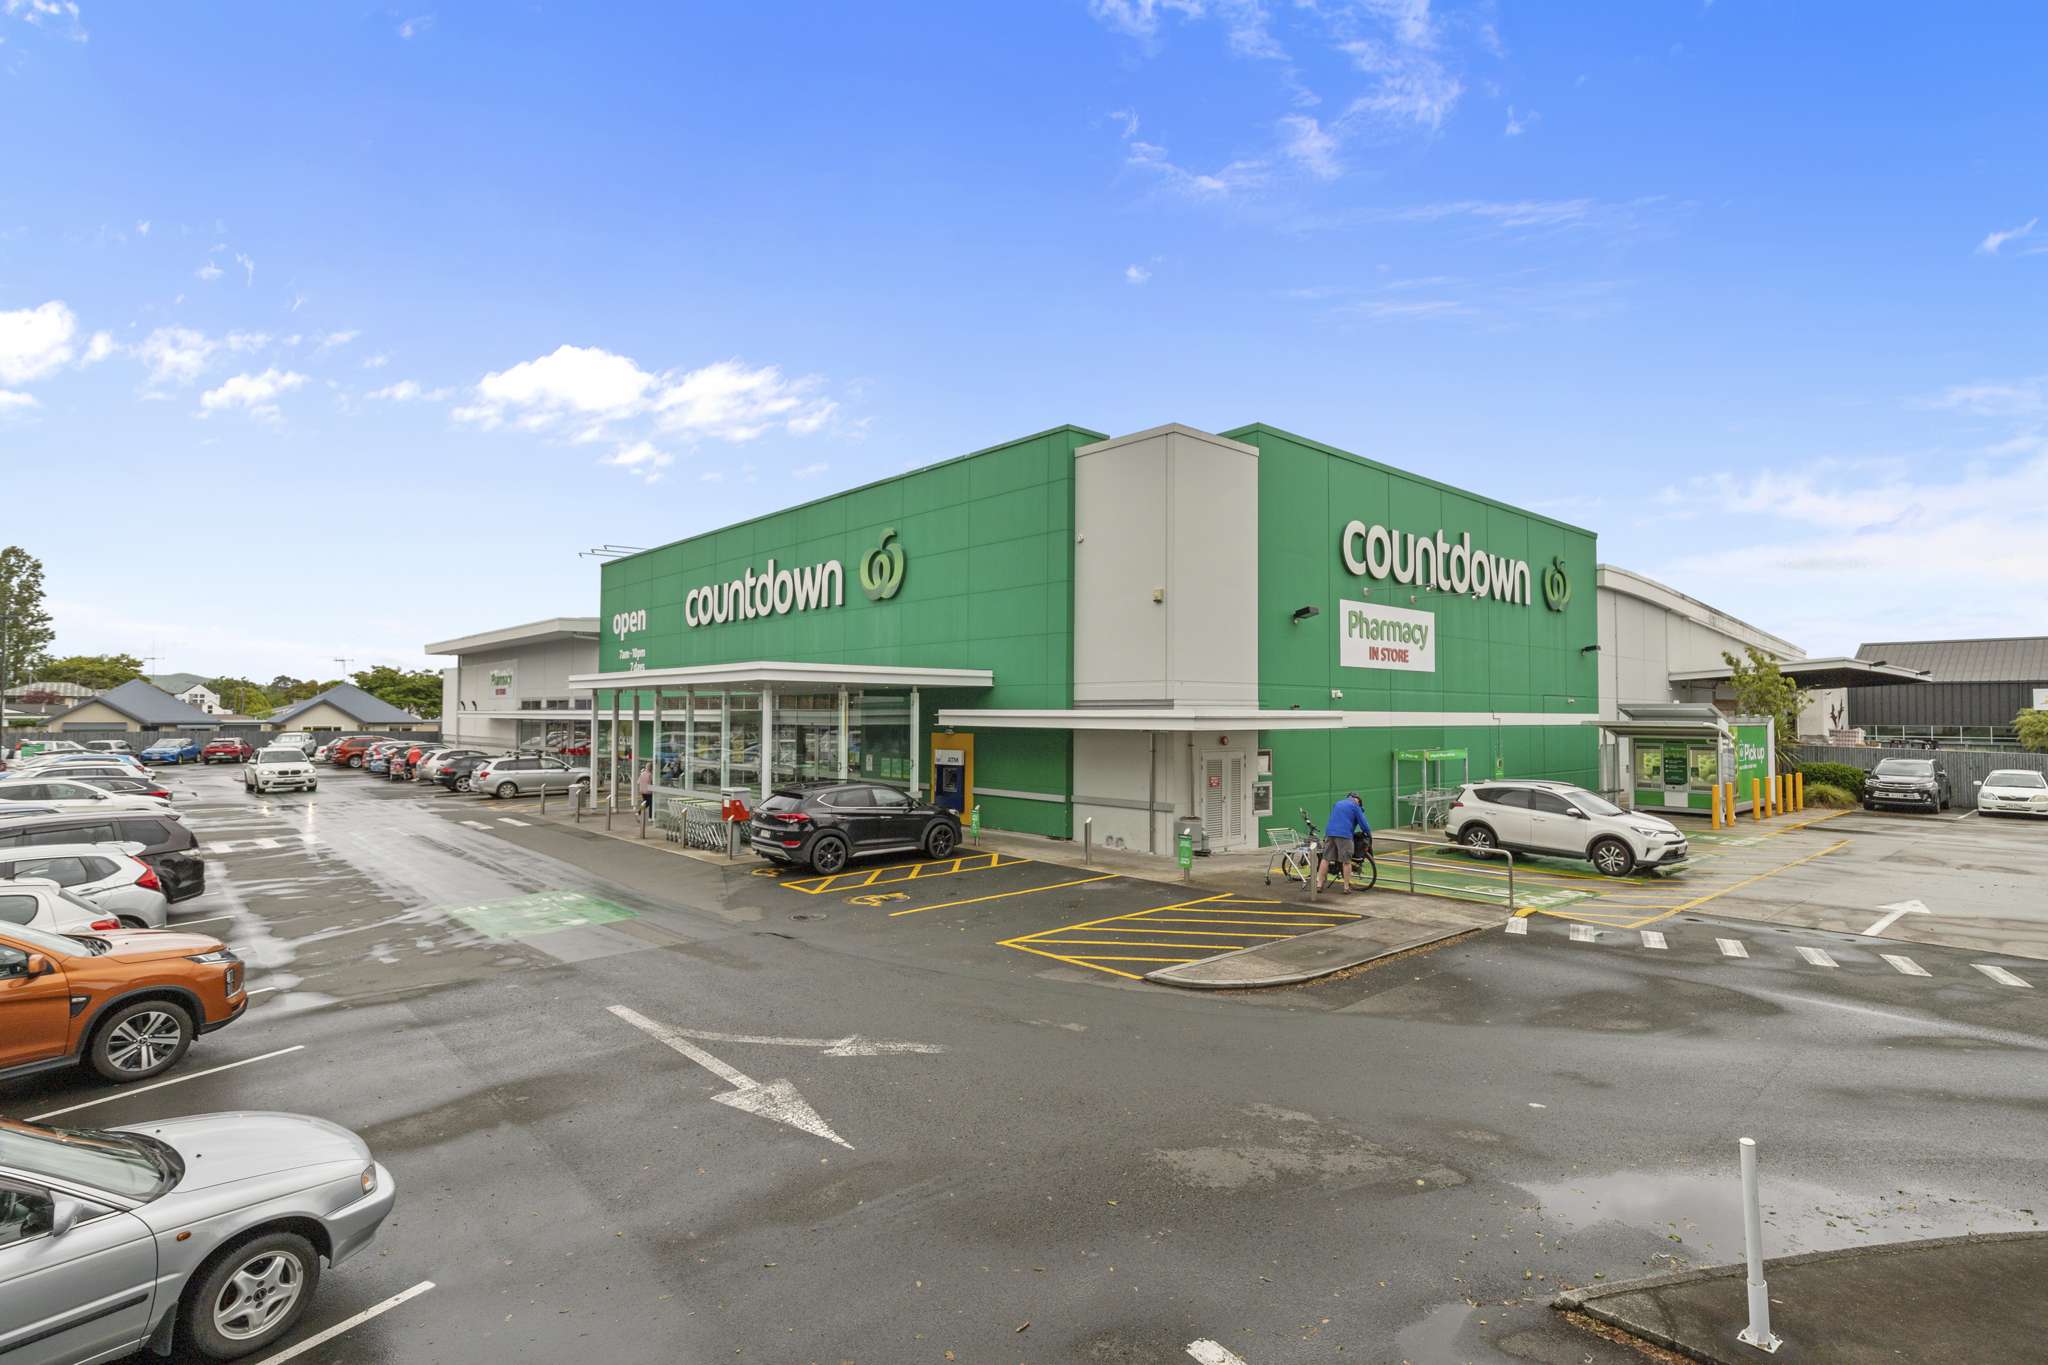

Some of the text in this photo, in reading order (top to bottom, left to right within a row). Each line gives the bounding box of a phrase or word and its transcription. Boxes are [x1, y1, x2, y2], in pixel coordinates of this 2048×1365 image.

[1343, 520, 1531, 606] countdown
[685, 559, 844, 627] countdown
[612, 609, 646, 641] open
[1347, 609, 1429, 651] Pharmacy
[1369, 646, 1409, 663] IN STORE
